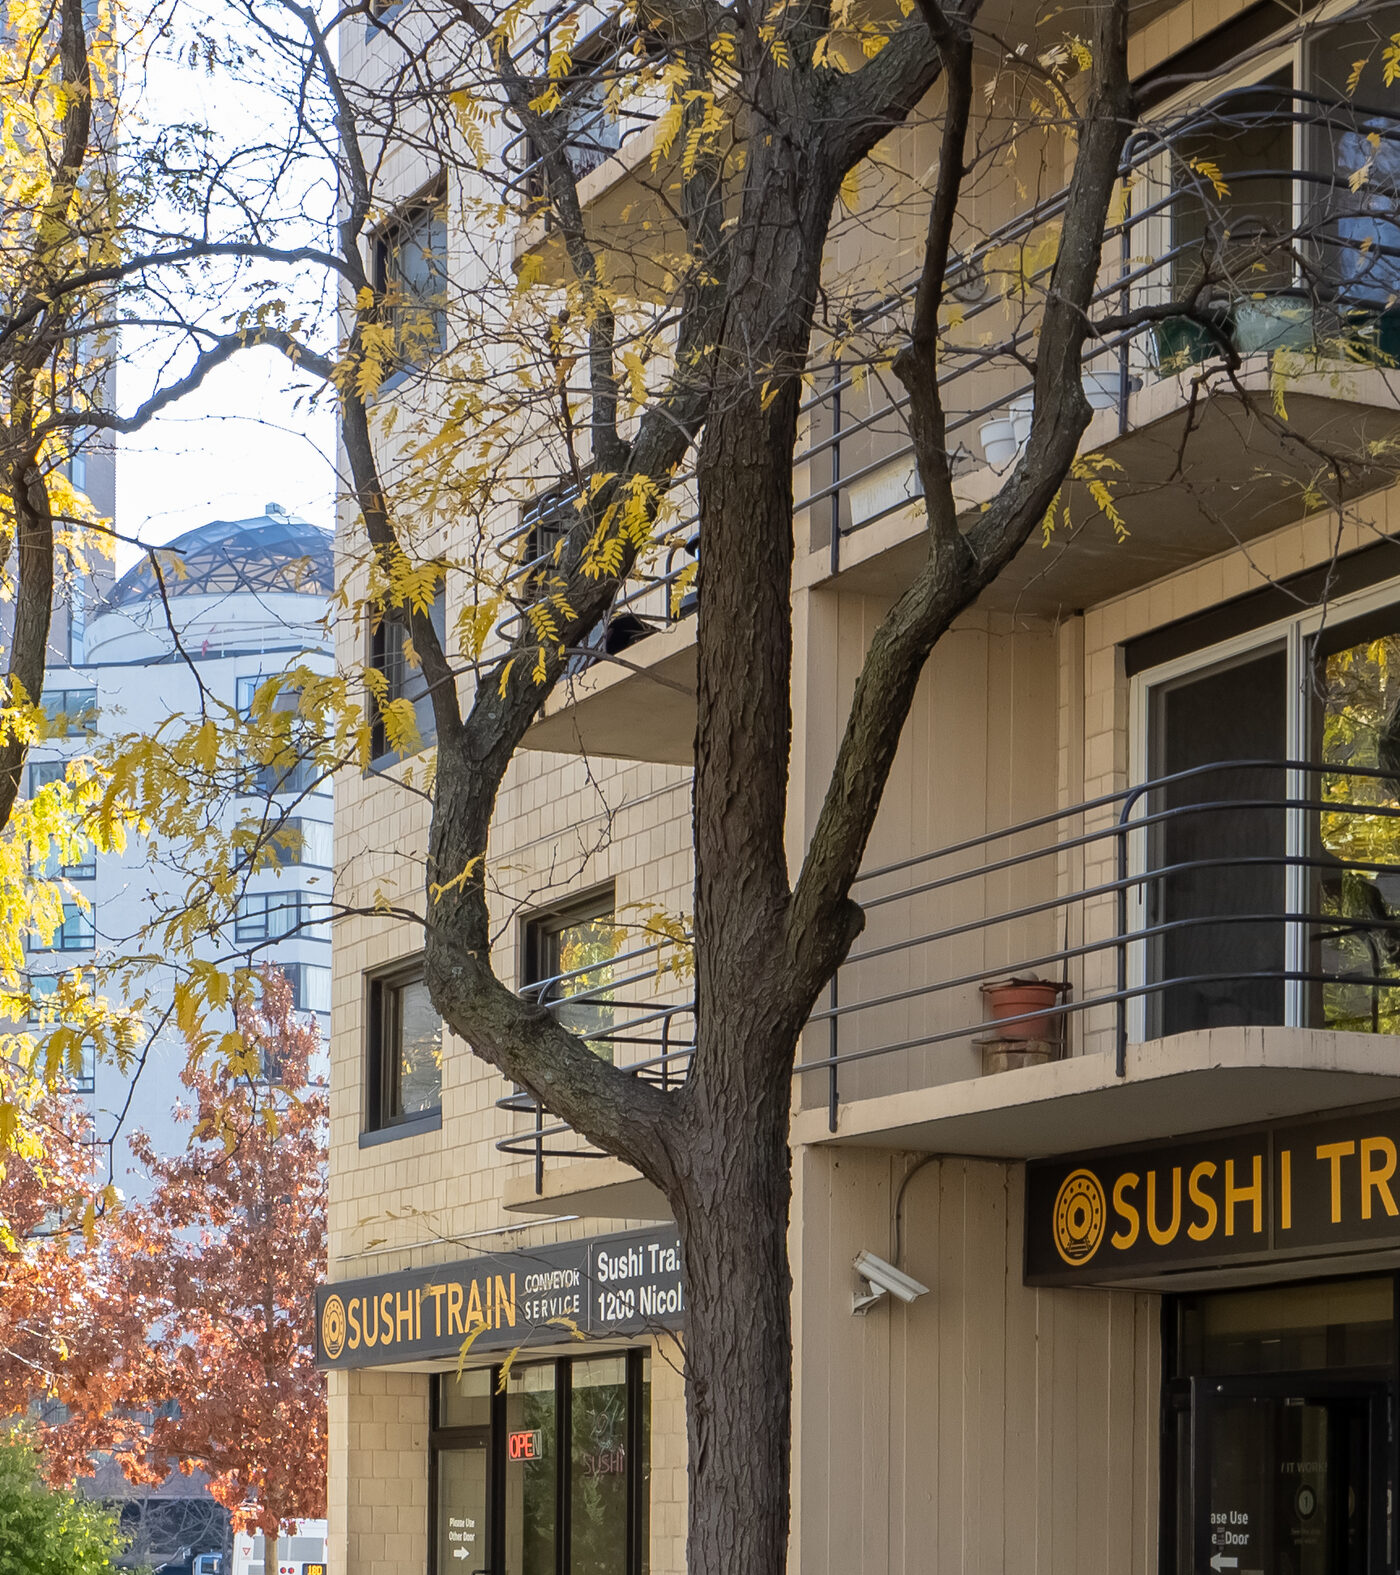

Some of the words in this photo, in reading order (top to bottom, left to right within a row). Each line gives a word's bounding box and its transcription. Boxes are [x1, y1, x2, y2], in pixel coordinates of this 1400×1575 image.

[1111, 1151, 1292, 1250] SUSHI
[598, 1246, 643, 1283] Sushi
[648, 1240, 680, 1274] Trai
[524, 1269, 580, 1294] CONVEYOR
[347, 1288, 421, 1350] SUSHI
[429, 1272, 516, 1337] TRAIN
[525, 1294, 580, 1320] SERVICE
[598, 1288, 635, 1321] 1200
[640, 1281, 686, 1316] Nicol
[509, 1433, 540, 1459] OPEN
[584, 1451, 623, 1474] SUSHI
[465, 1517, 475, 1528] Use
[1210, 1513, 1227, 1524] ase
[1230, 1511, 1249, 1525] Use
[1225, 1531, 1250, 1545] Door
